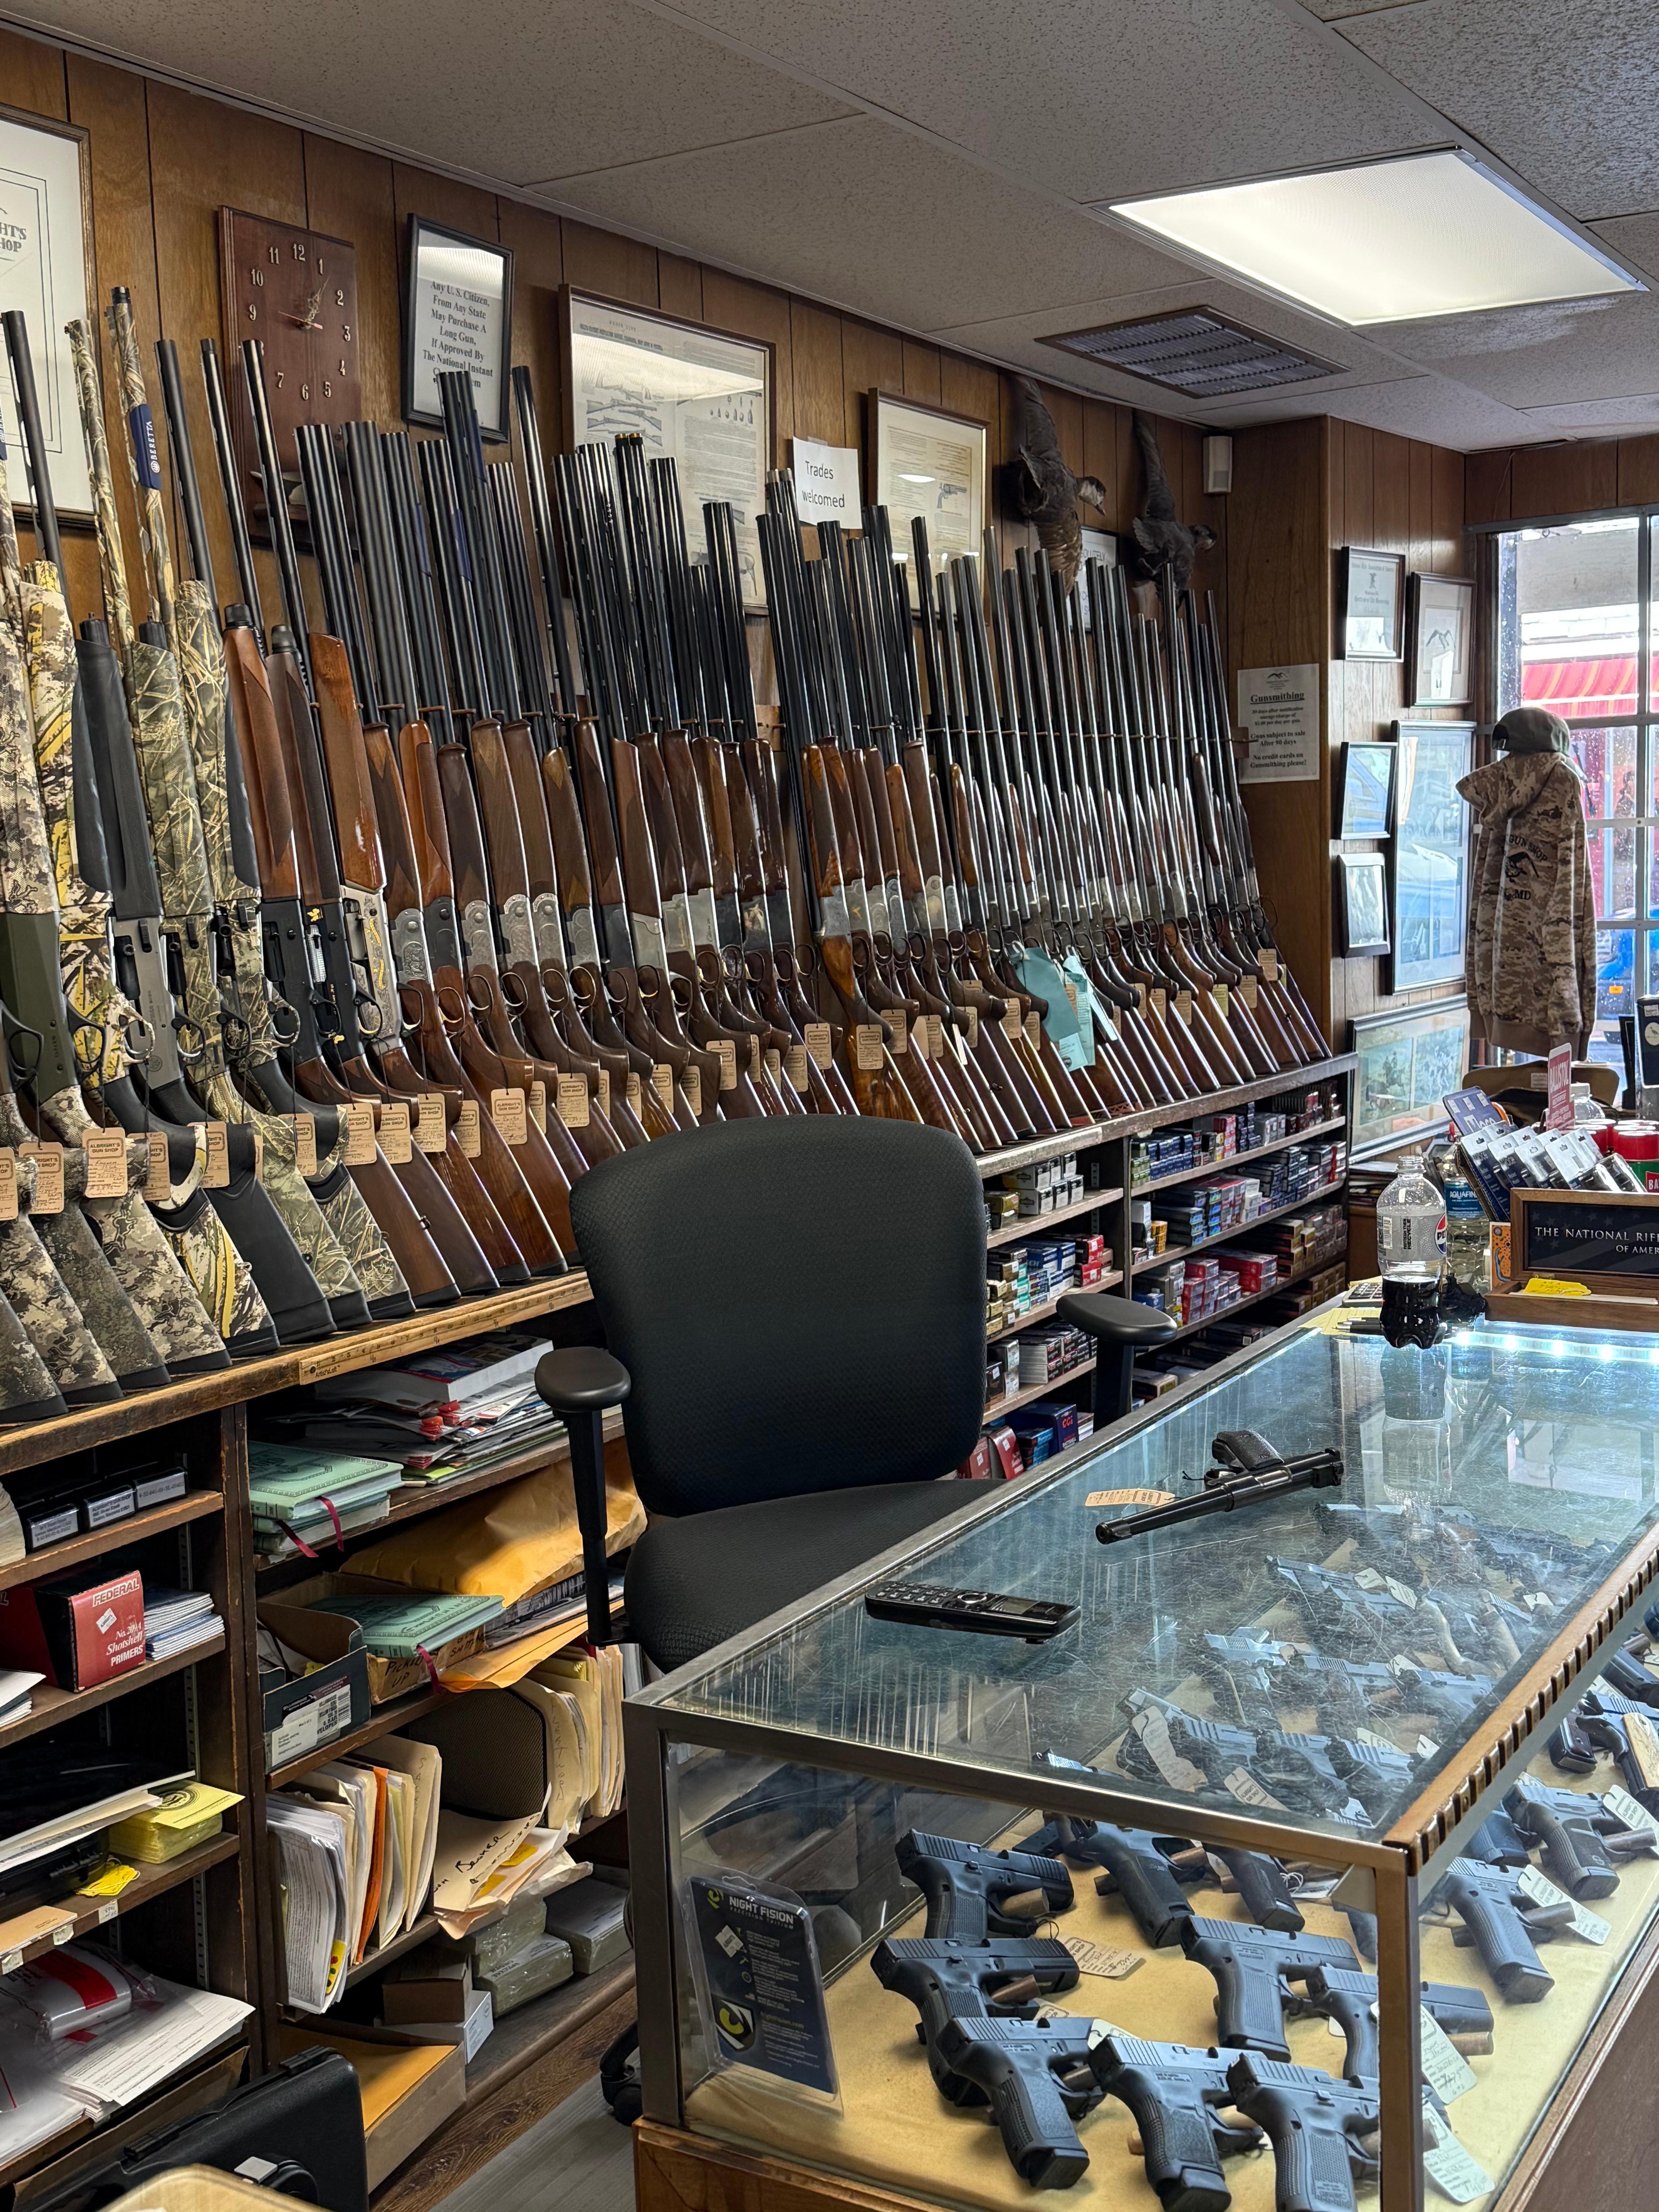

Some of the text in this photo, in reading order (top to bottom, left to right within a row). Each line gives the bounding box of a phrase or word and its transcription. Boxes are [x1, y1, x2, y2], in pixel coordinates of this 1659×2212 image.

[269, 247, 280, 264] 11
[293, 244, 306, 261] 12
[318, 258, 323, 275] 1
[251, 268, 263, 286] 10
[337, 290, 343, 306] 2
[431, 281, 445, 293] Any
[464, 290, 489, 307] Citizen,
[249, 304, 256, 321] 9
[434, 295, 486, 319] From Any State
[431, 309, 486, 333] May Purchase A
[344, 326, 350, 341] 3
[440, 326, 476, 346] Long Gun,
[432, 338, 484, 362] If Approved By
[340, 360, 345, 376] 4
[424, 350, 493, 377] The National Instant
[277, 372, 284, 388] 7
[302, 384, 309, 400] 6
[324, 381, 331, 398] 5
[146, 421, 158, 460] BERETTA
[805, 461, 833, 479] Trades
[802, 489, 845, 508] welcomed
[1251, 692, 1304, 703] Gunsmithing
[1509, 834, 1548, 862] GUN SHOP
[1515, 889, 1531, 900] MD
[1449, 1191, 1477, 1199] AQUAFIN
[1535, 1227, 1559, 1237] THE
[1566, 1229, 1629, 1241] NATIONAL
[1632, 1246, 1659, 1254] AMER
[93, 1578, 140, 1607] FEDERAL
[106, 1631, 143, 1656] Shotshell
[111, 1645, 143, 1666] PRIMERS
[392, 1672, 409, 1688] UP
[317, 1721, 337, 1735] VELOPES
[729, 1896, 793, 1924] NIGHT FISION
[730, 1907, 793, 1929] PRECISION TRITIUM
